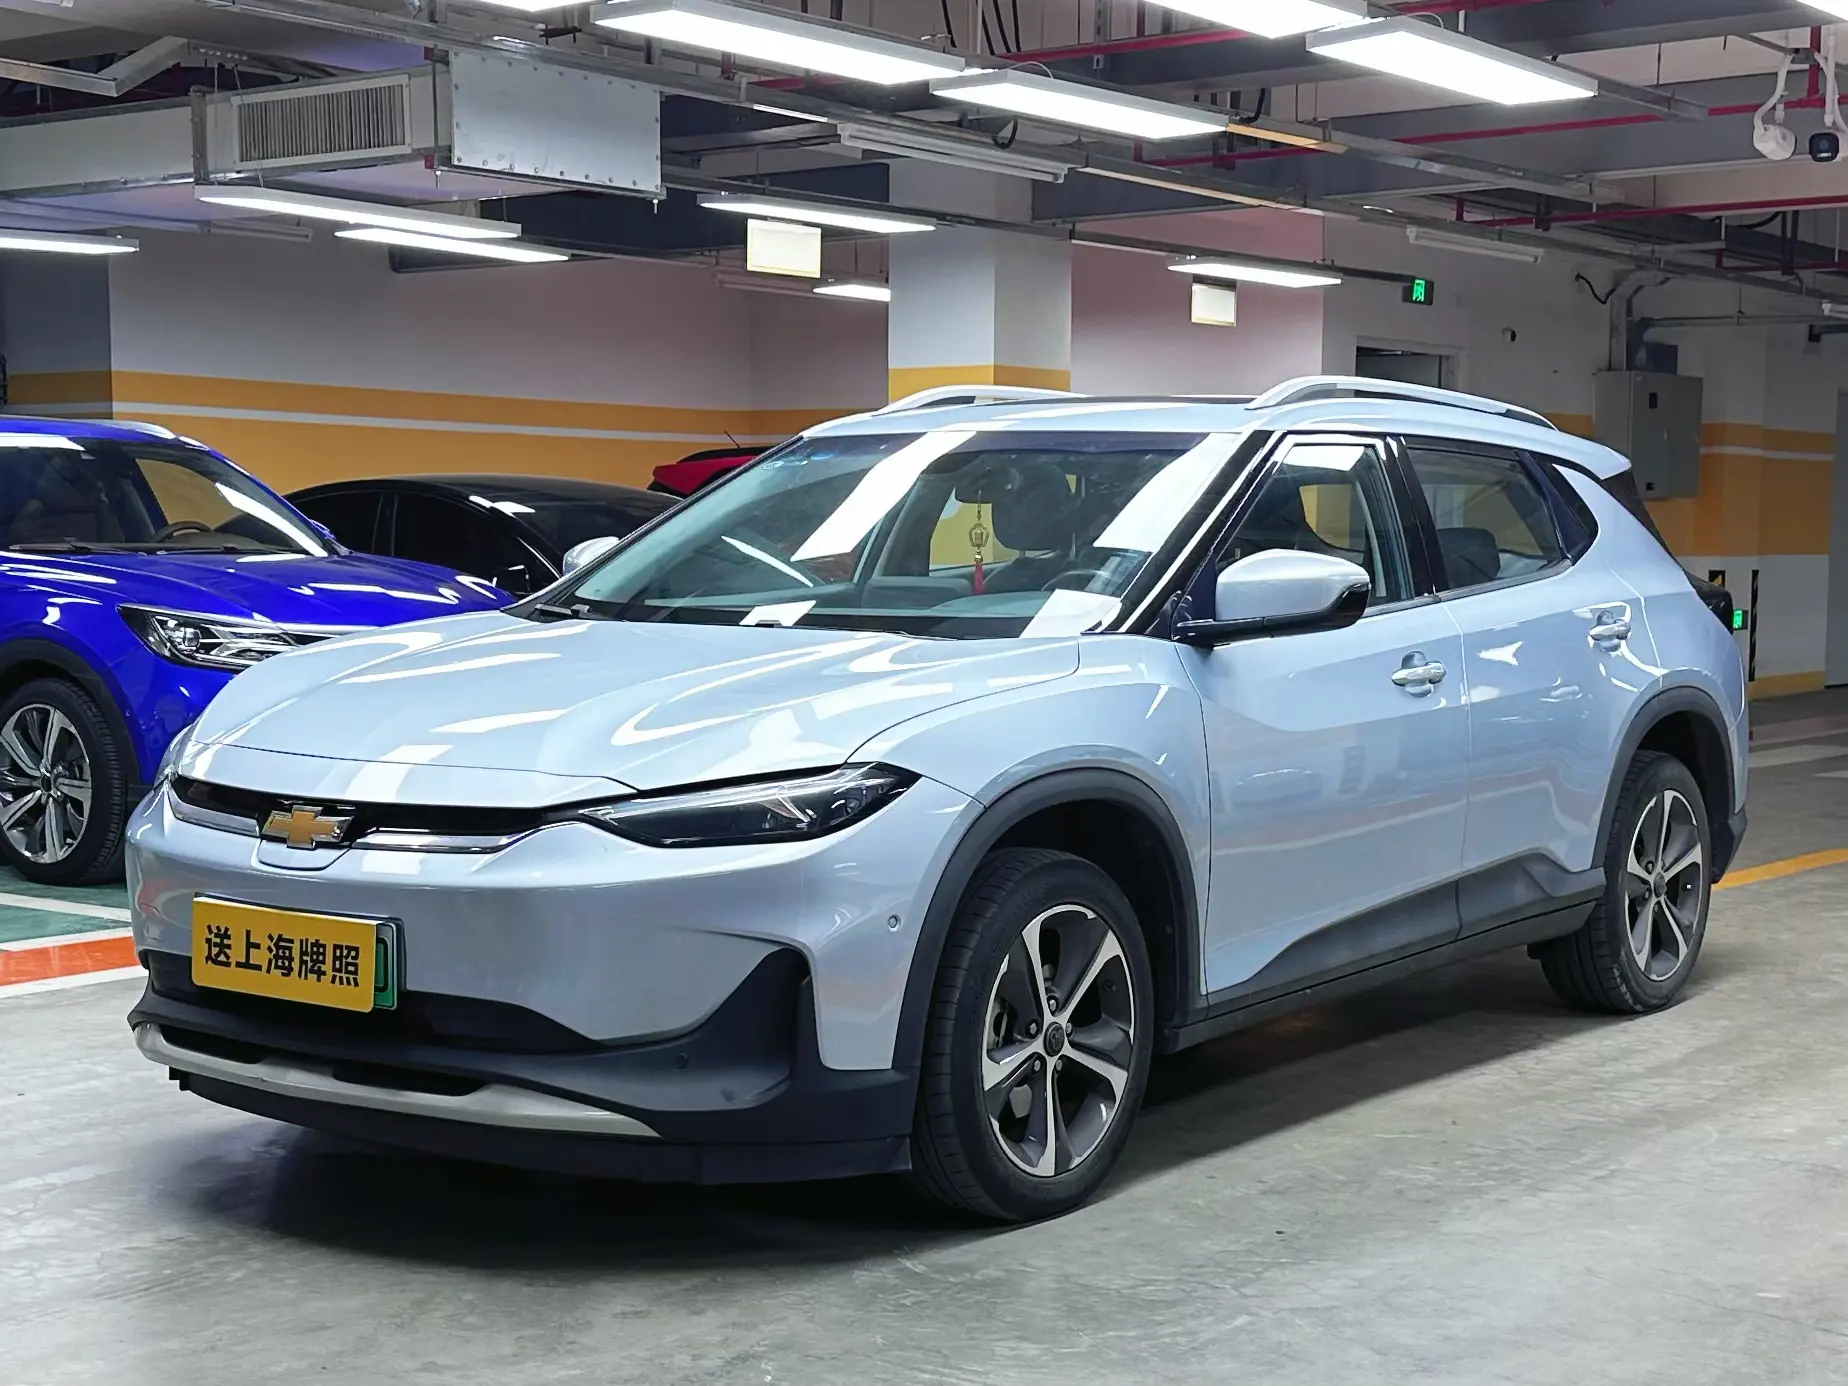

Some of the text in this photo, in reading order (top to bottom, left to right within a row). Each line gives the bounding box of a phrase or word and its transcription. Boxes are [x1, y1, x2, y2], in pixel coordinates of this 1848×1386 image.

[205, 924, 360, 987] 送上海牌照
